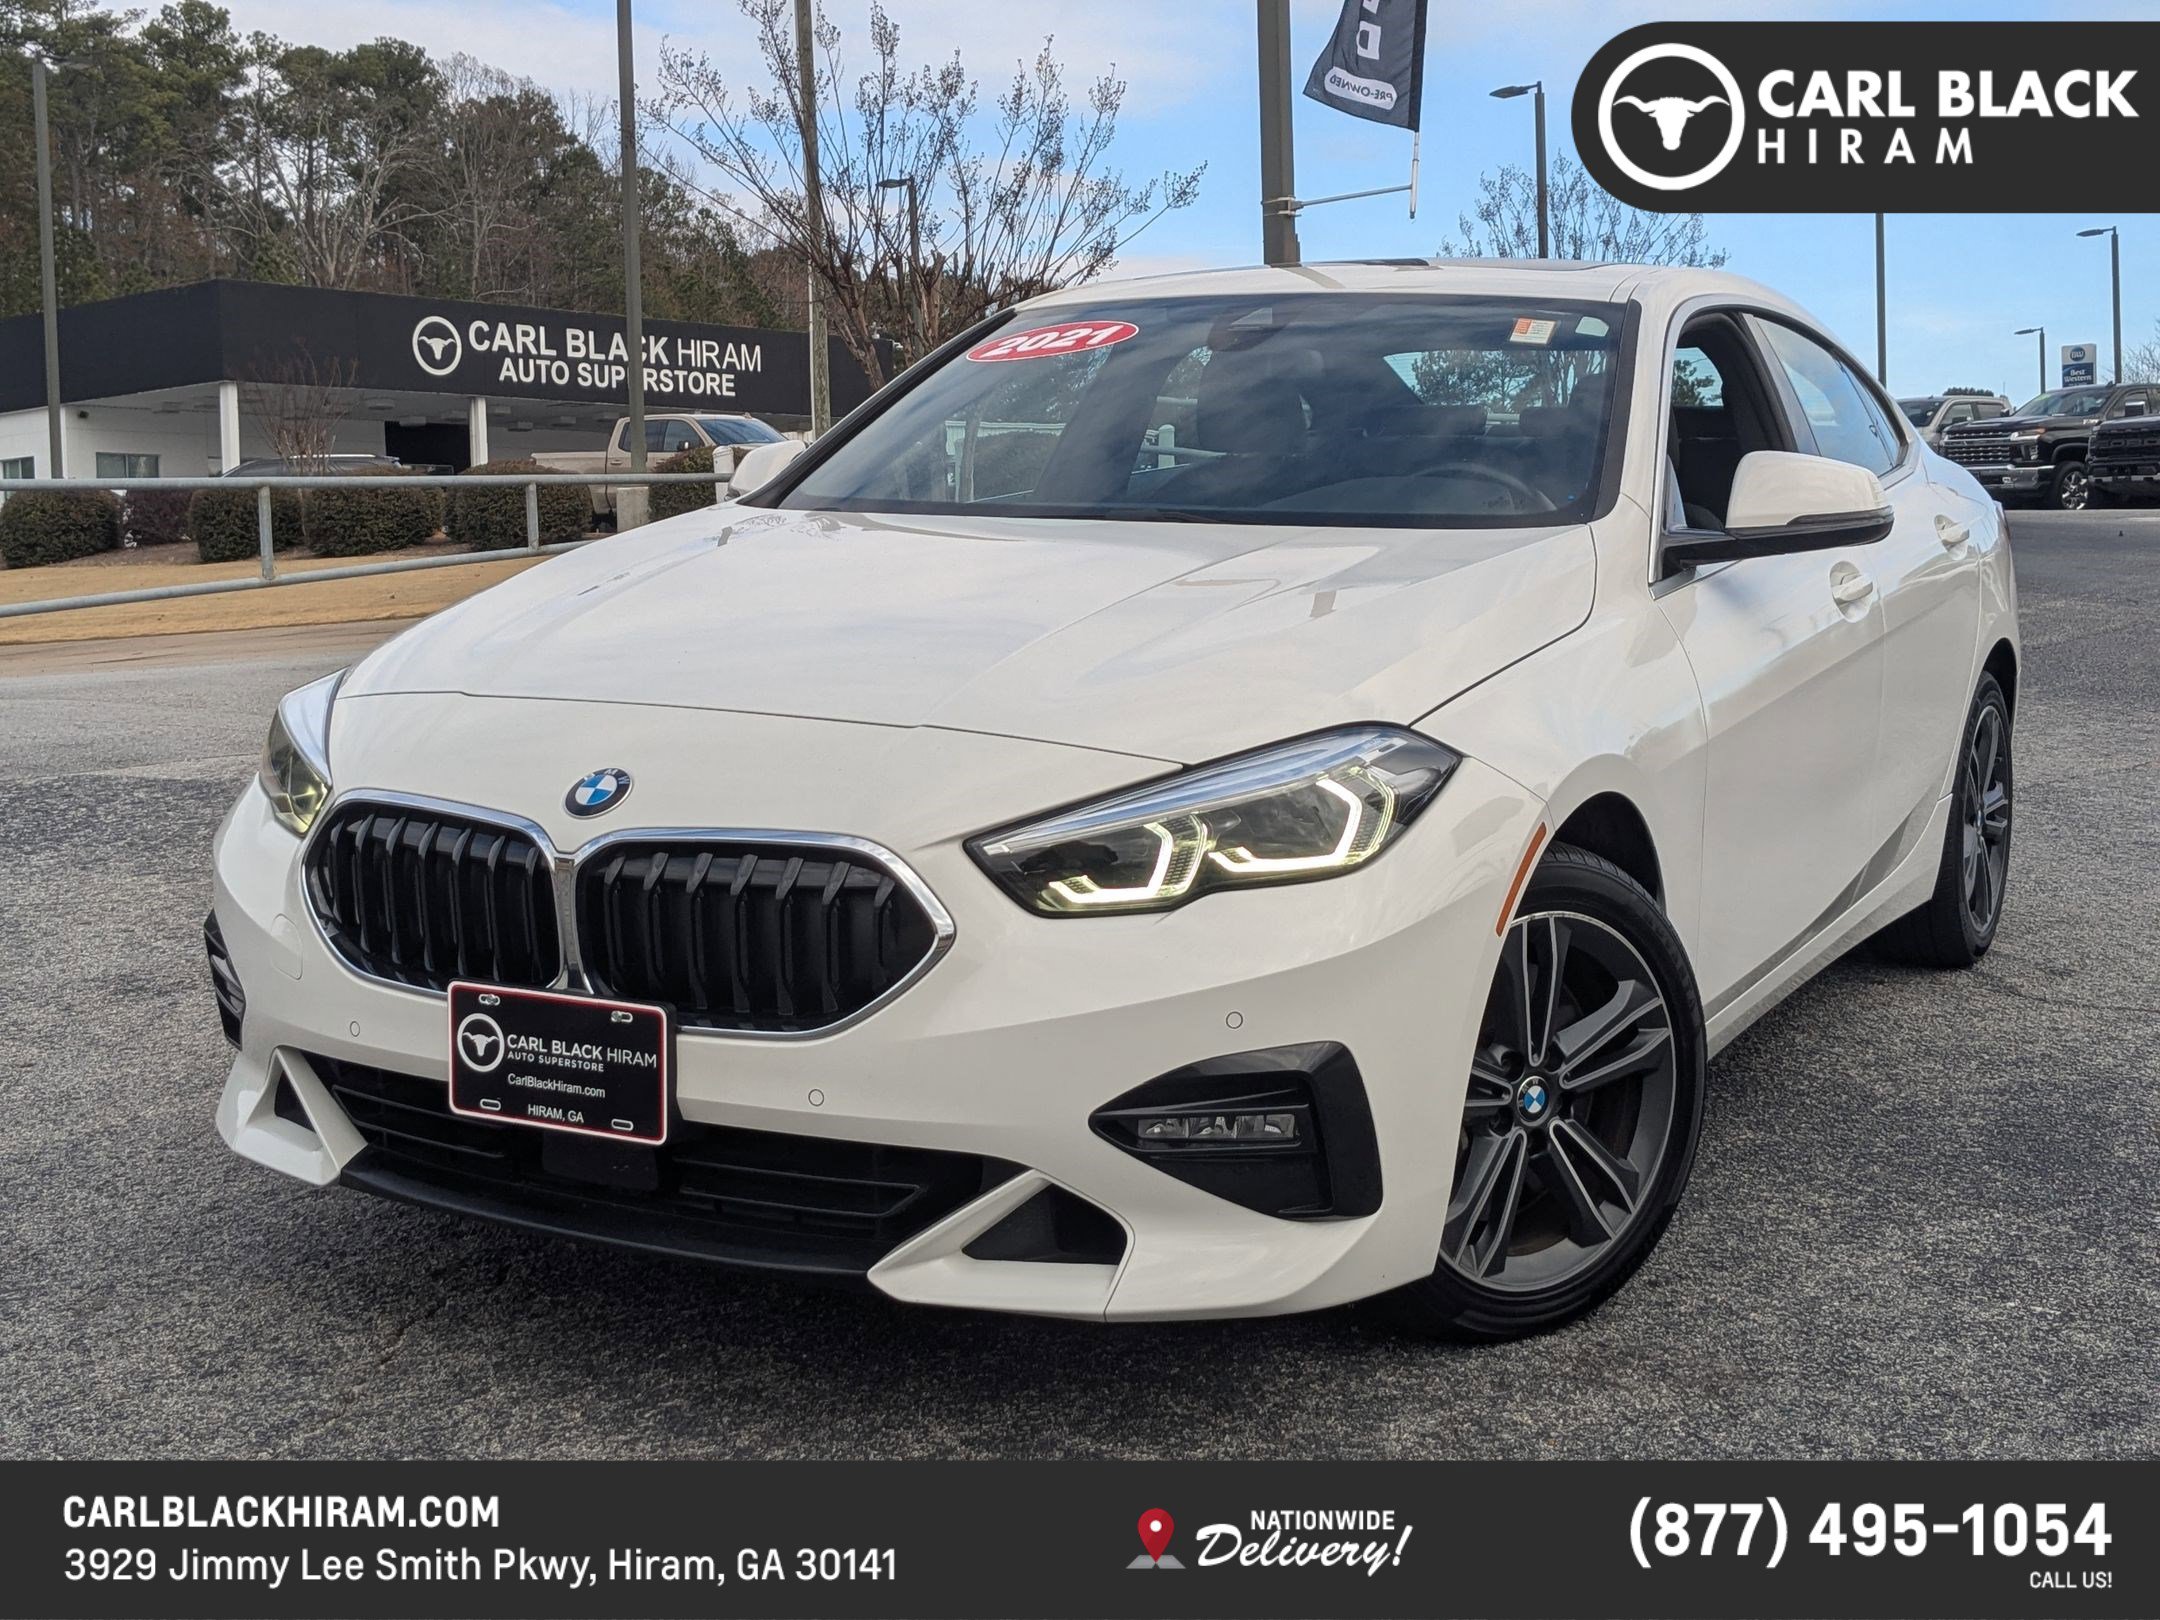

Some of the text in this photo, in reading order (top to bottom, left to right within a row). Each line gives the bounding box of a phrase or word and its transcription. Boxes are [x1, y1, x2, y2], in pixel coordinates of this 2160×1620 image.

[468, 320, 762, 372] CARL BLAK HIRAM
[980, 325, 1124, 358] 2021
[499, 357, 736, 397] AUTO SUPRSTORE
[2063, 375, 2092, 383] Western
[2070, 369, 2086, 377] Best
[507, 1034, 657, 1069] CARL BLACK HIRAM
[507, 1050, 605, 1073] AUTO SUPERSTORE
[507, 1073, 606, 1098] CarlBlackHiram.com
[528, 1103, 585, 1124] HIRAM, GA
